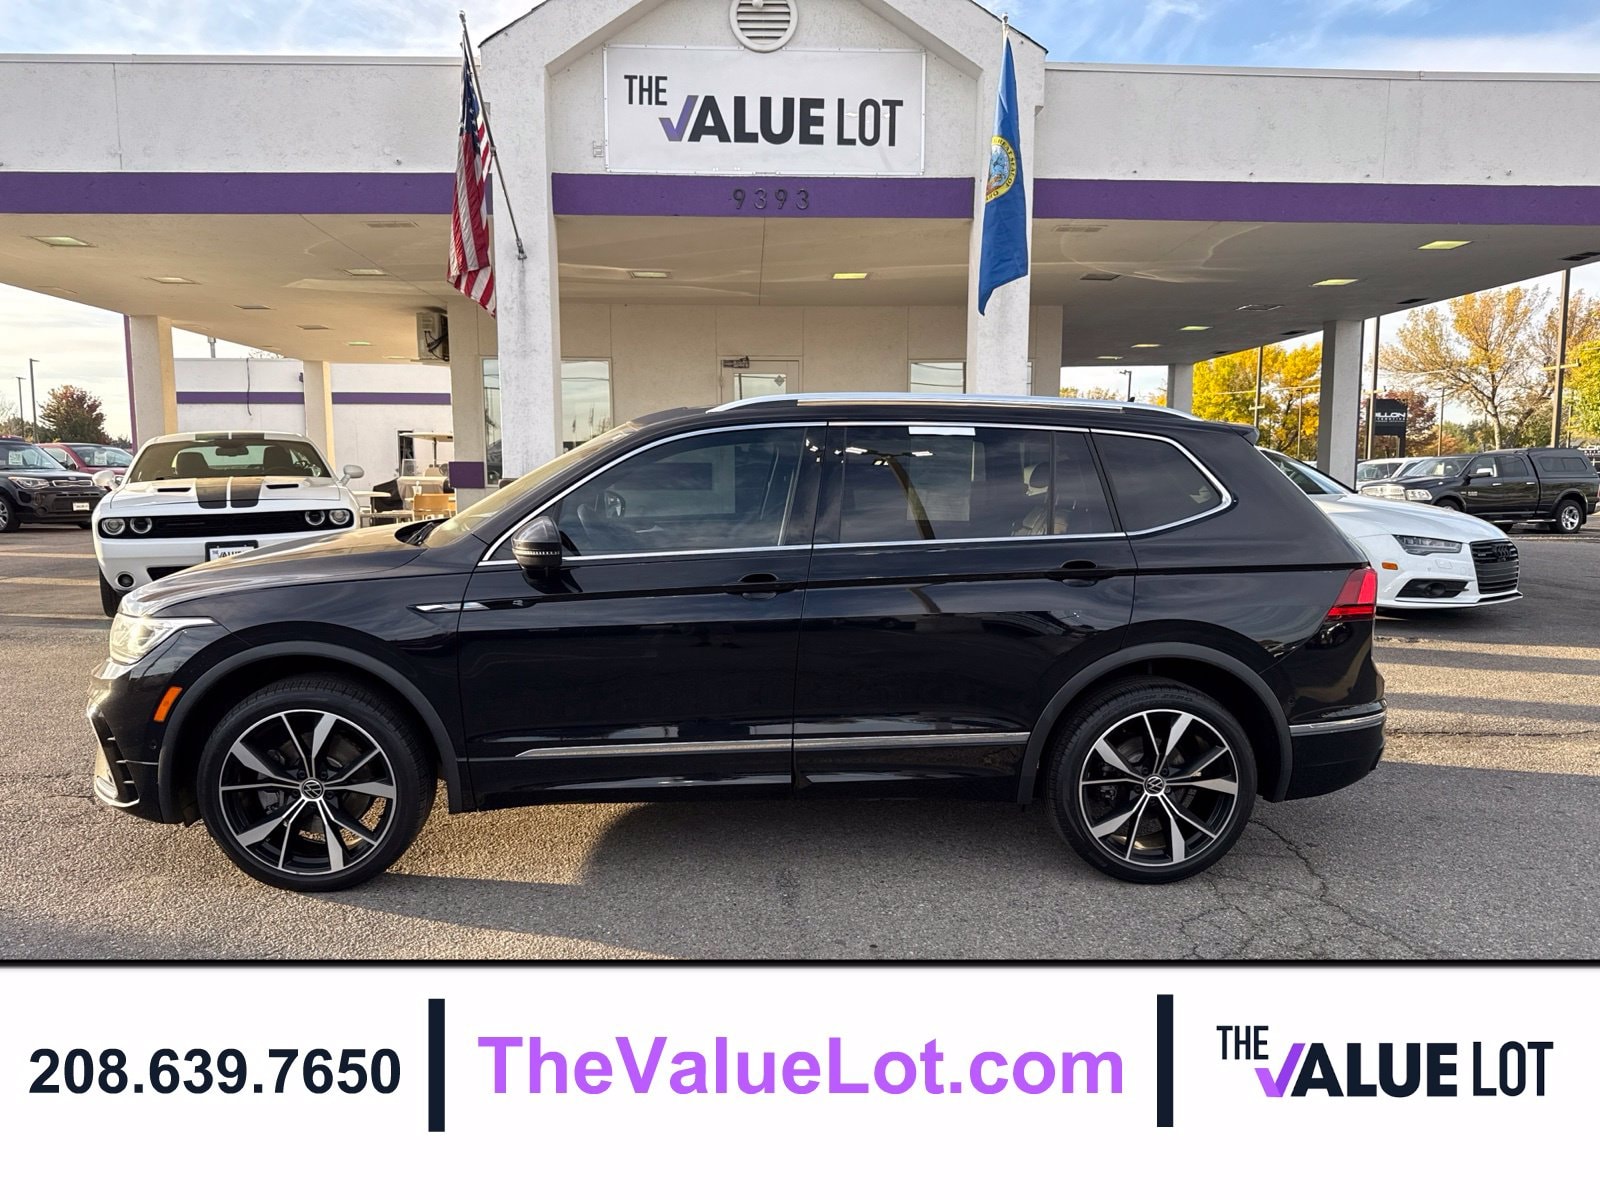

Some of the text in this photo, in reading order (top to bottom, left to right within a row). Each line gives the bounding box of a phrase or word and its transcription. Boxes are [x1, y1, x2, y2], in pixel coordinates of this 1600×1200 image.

[623, 74, 668, 106] THE
[836, 97, 904, 147] LOT
[732, 187, 809, 211] 9393
